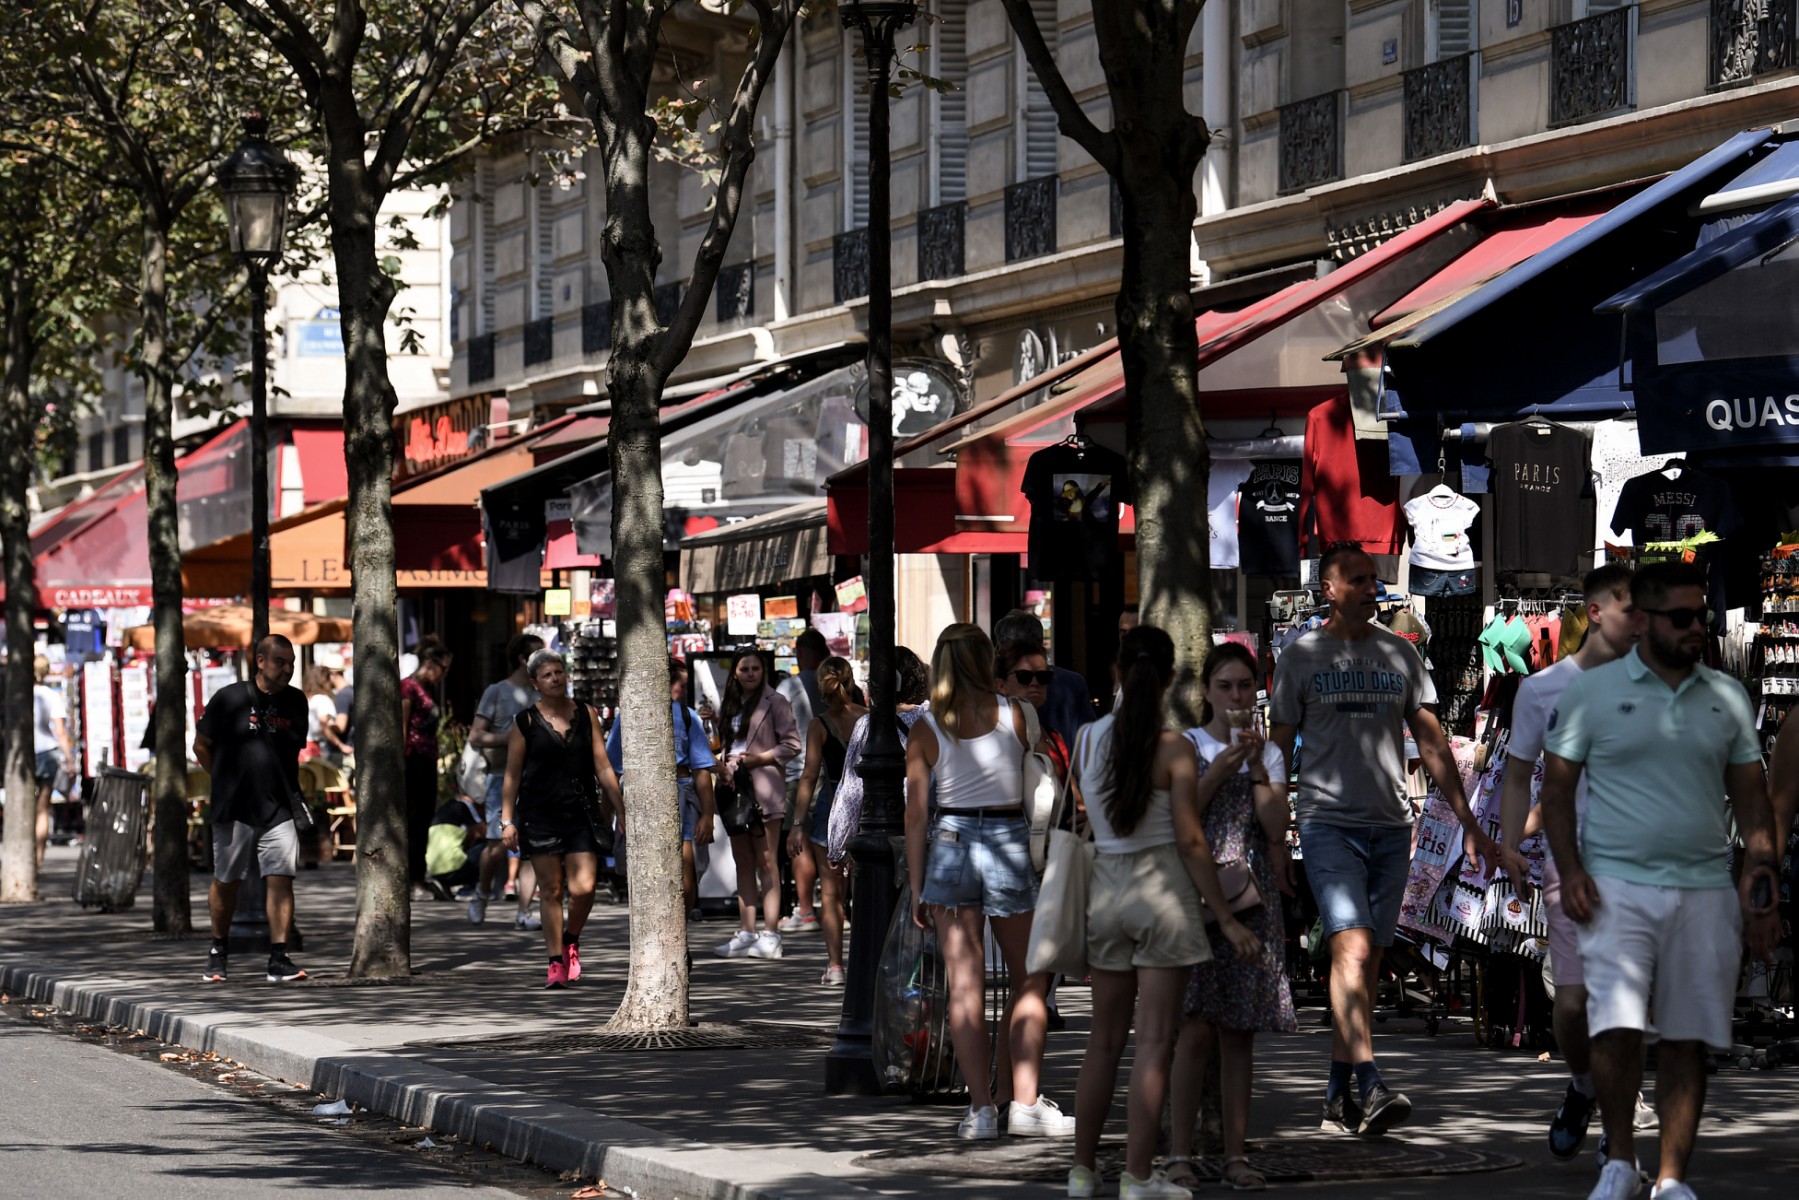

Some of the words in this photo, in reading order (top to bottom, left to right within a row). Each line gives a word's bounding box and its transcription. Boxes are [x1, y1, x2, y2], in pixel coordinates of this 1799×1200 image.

[1253, 464, 1299, 485] PARIS
[1514, 463, 1561, 485] PARIS
[1520, 483, 1552, 493] FRANCE
[1652, 491, 1697, 507] MESSI
[500, 520, 530, 529] PARIS
[302, 559, 339, 582] LE
[55, 589, 141, 606] CADEAUX
[1314, 670, 1366, 693] STUPID
[1371, 670, 1403, 693] DOES
